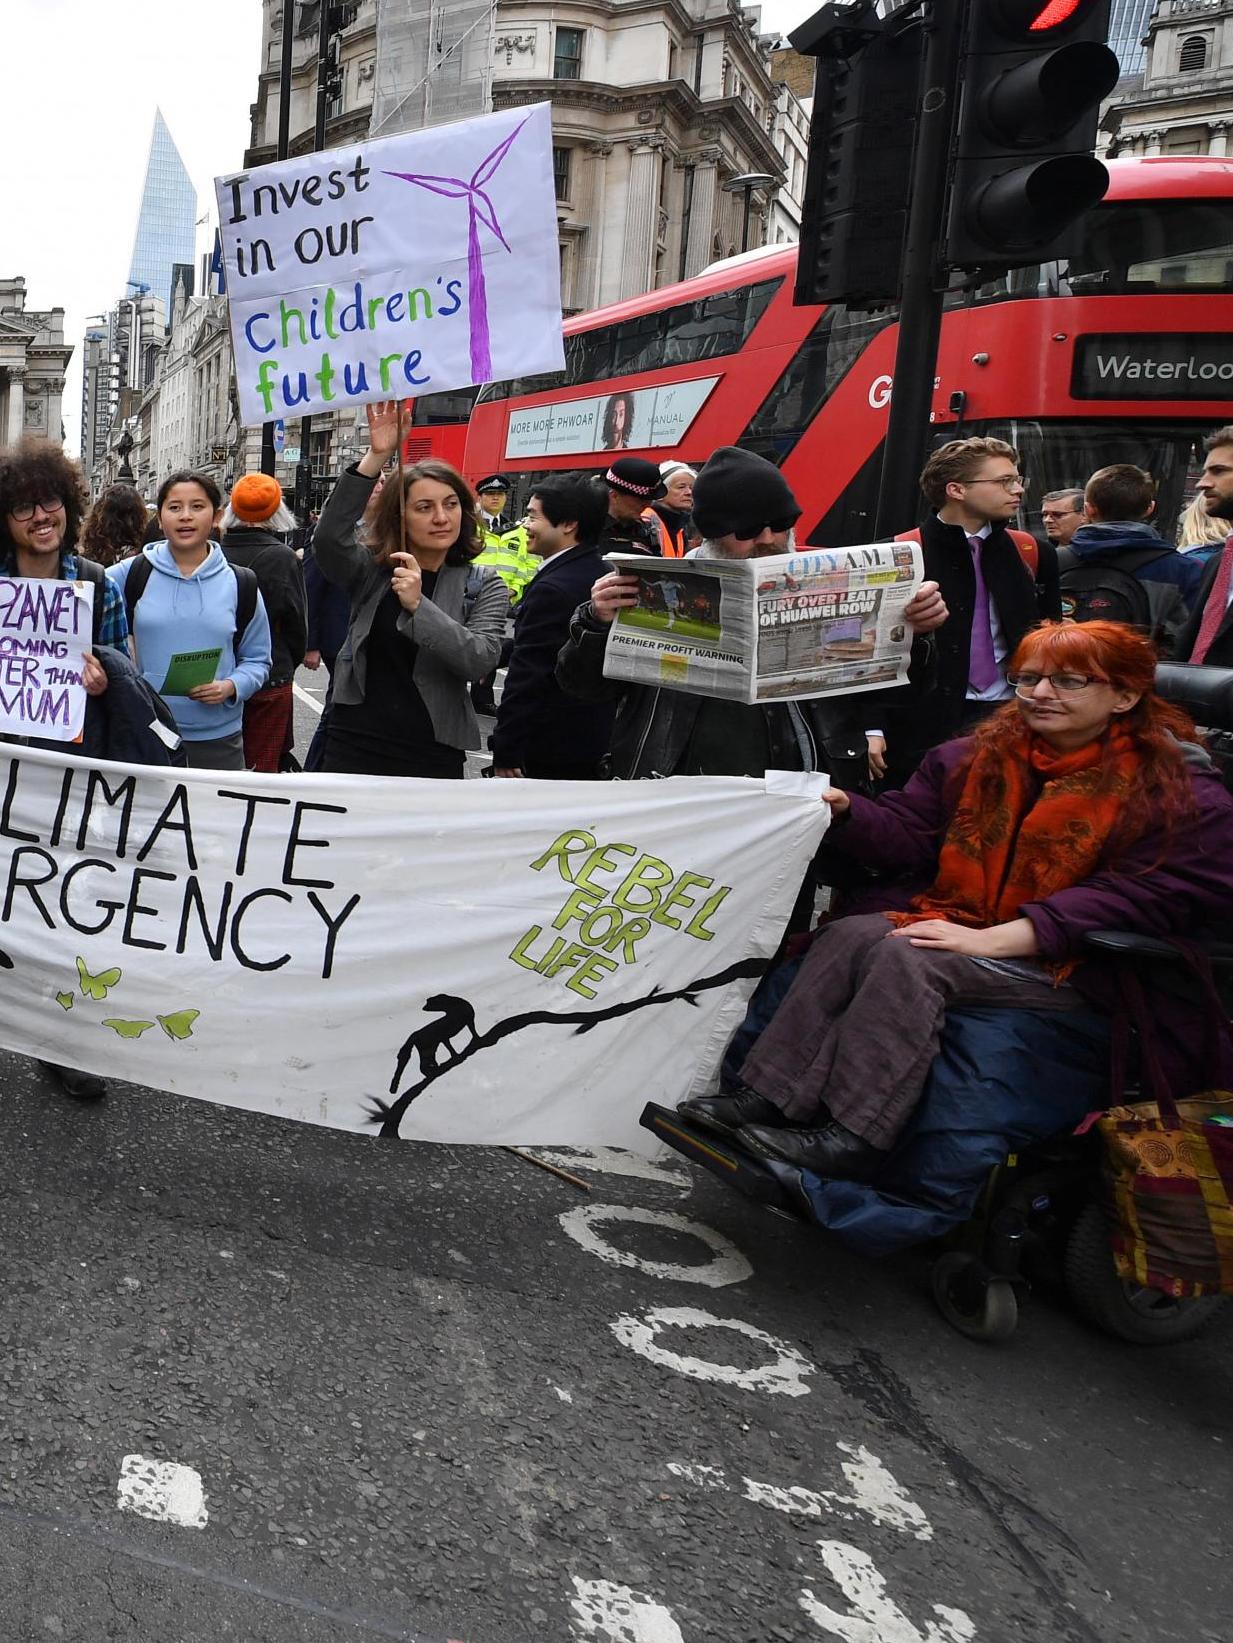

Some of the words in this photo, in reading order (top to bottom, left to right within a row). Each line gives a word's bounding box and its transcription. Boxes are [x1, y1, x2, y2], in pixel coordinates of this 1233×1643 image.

[222, 156, 371, 224] Invest
[236, 238, 276, 277] in
[294, 216, 374, 264] our
[255, 350, 431, 414] future
[1096, 355, 1233, 380] Waterloo
[511, 422, 531, 435] MORE
[533, 417, 555, 431] MORE
[557, 412, 594, 430] PHWOAR
[787, 554, 839, 575] CITY
[844, 548, 886, 569] A.M.
[759, 598, 796, 614] FURY
[798, 594, 837, 608] OVER
[839, 590, 878, 604] LEAK
[760, 612, 778, 627] OF
[780, 604, 836, 624] HUAWEI
[839, 600, 876, 616] ROW
[612, 634, 656, 649] PREMIER
[657, 643, 694, 656] PROFIT
[695, 649, 744, 664] WARNING
[44, 667, 83, 686] THAN
[529, 829, 732, 941] REBEL
[551, 888, 652, 964] FOR
[508, 925, 619, 1000] LIFE
